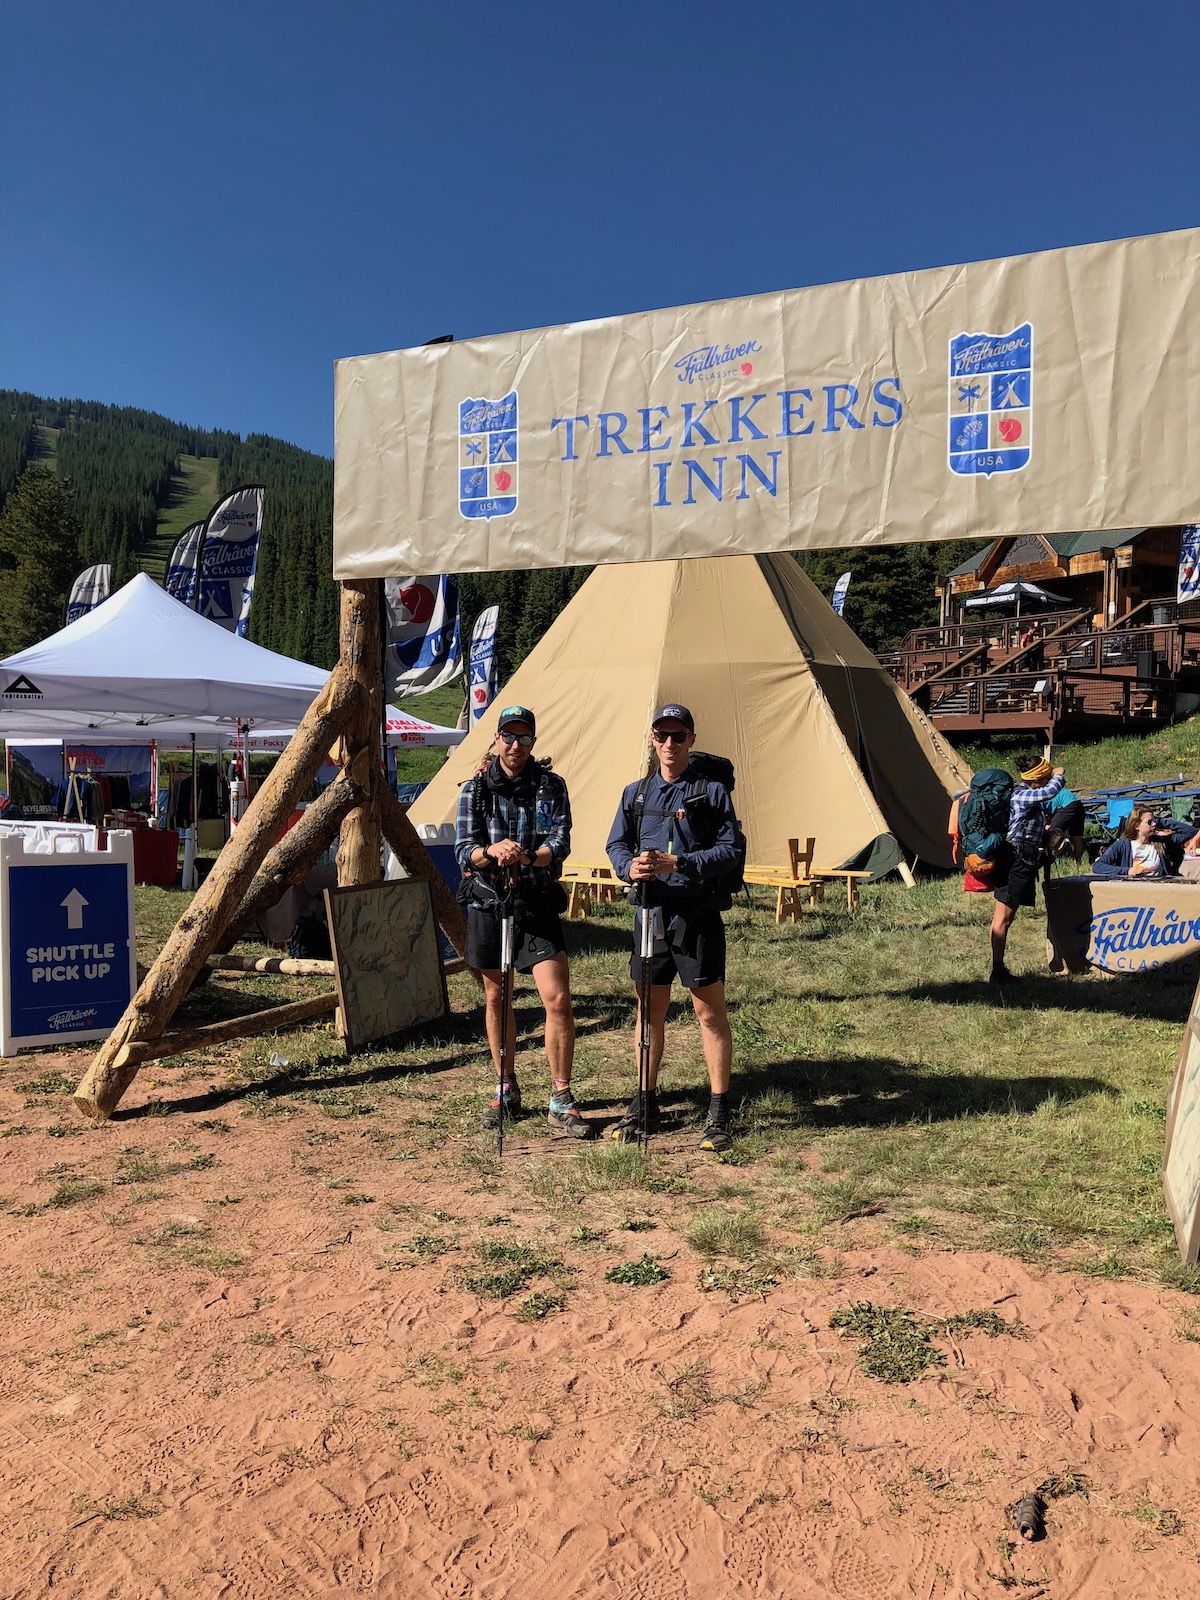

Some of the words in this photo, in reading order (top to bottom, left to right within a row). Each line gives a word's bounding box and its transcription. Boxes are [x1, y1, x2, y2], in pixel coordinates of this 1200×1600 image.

[674, 340, 762, 384] Fjällräven
[953, 337, 1029, 371] Fjällräven
[698, 369, 738, 380] CLASSIC
[974, 360, 1016, 370] CLASSIC
[551, 377, 905, 462] TREKKERS
[977, 455, 1003, 467] USA
[652, 450, 782, 508] INN
[480, 503, 498, 511] USA
[211, 566, 253, 575] CLASSIC
[26, 943, 115, 963] SHUTTLE
[32, 965, 80, 983] PICK
[84, 963, 111, 979] UP
[1117, 957, 1193, 976] CLASSIC
[61, 1021, 85, 1029] CLASSIC
